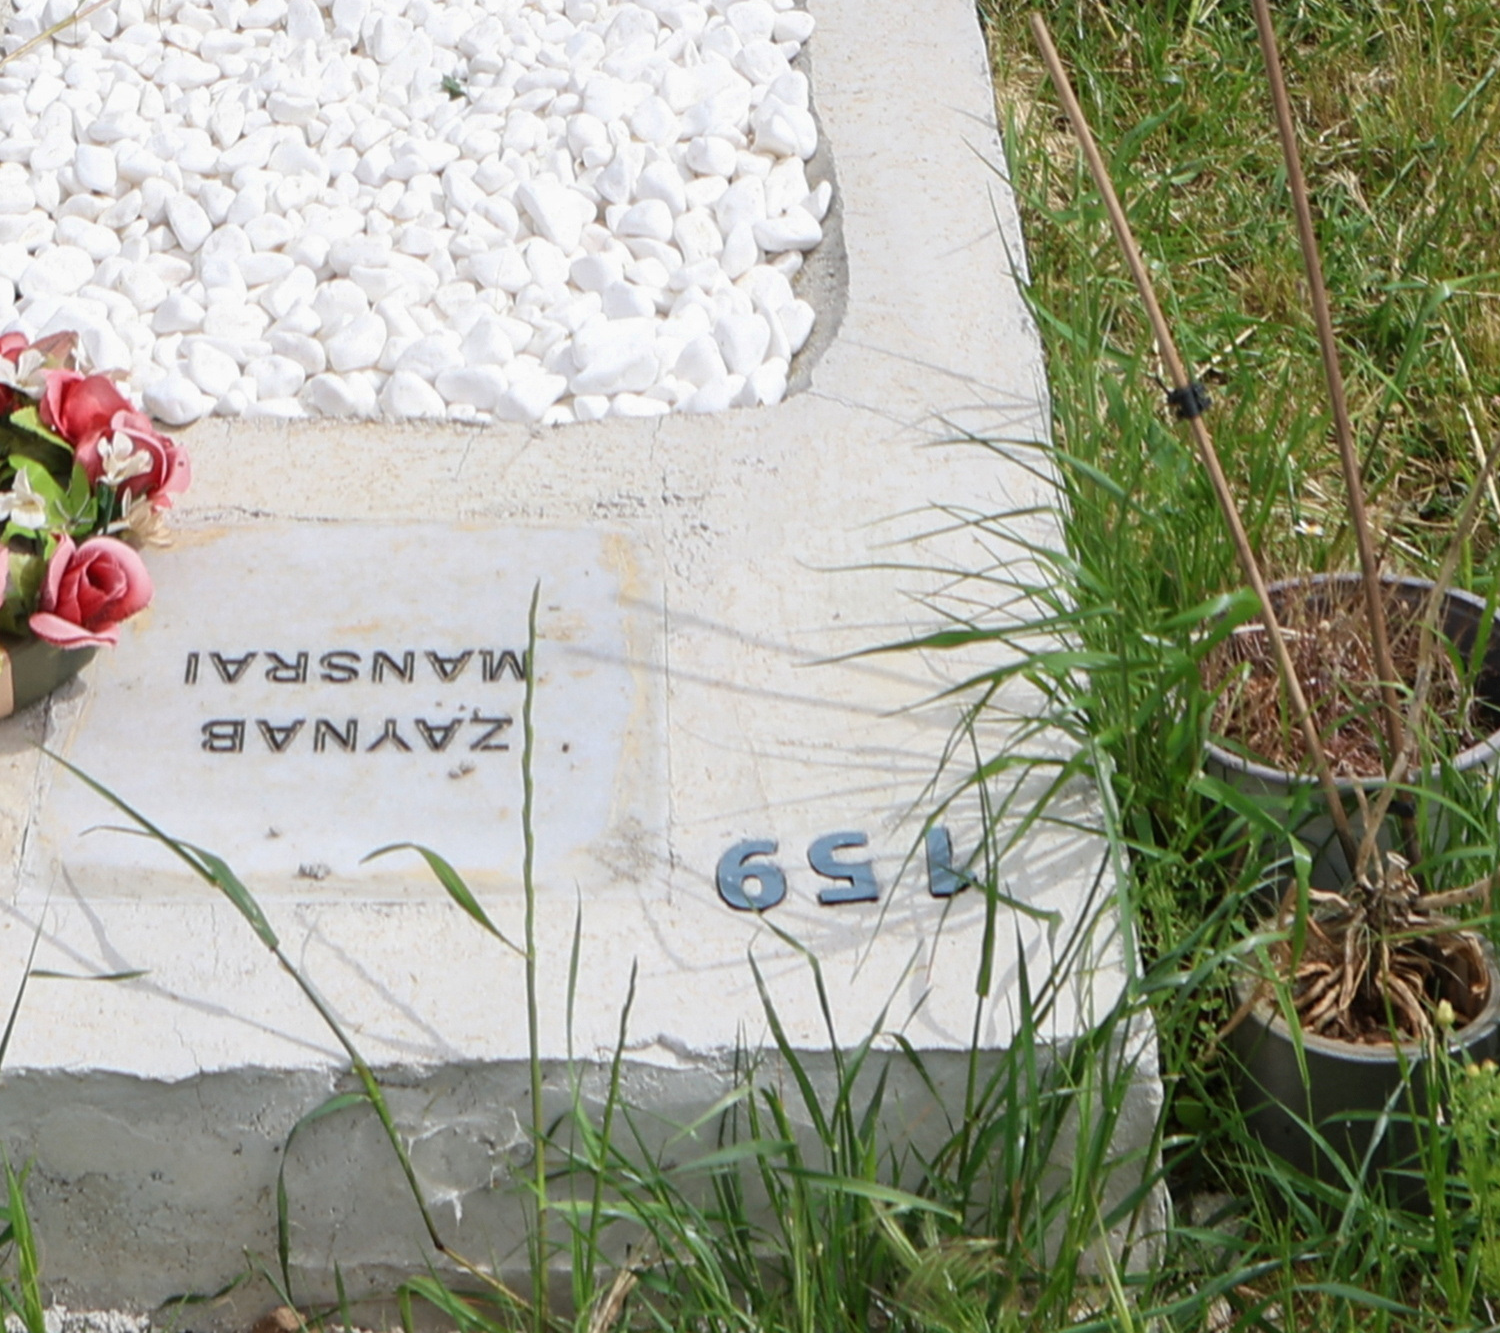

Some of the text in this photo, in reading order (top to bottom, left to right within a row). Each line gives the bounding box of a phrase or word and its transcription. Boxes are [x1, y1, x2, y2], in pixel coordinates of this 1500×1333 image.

[181, 647, 531, 686] MANSRAI
[198, 713, 514, 757] ZAYNAB
[713, 825, 968, 914] 159
